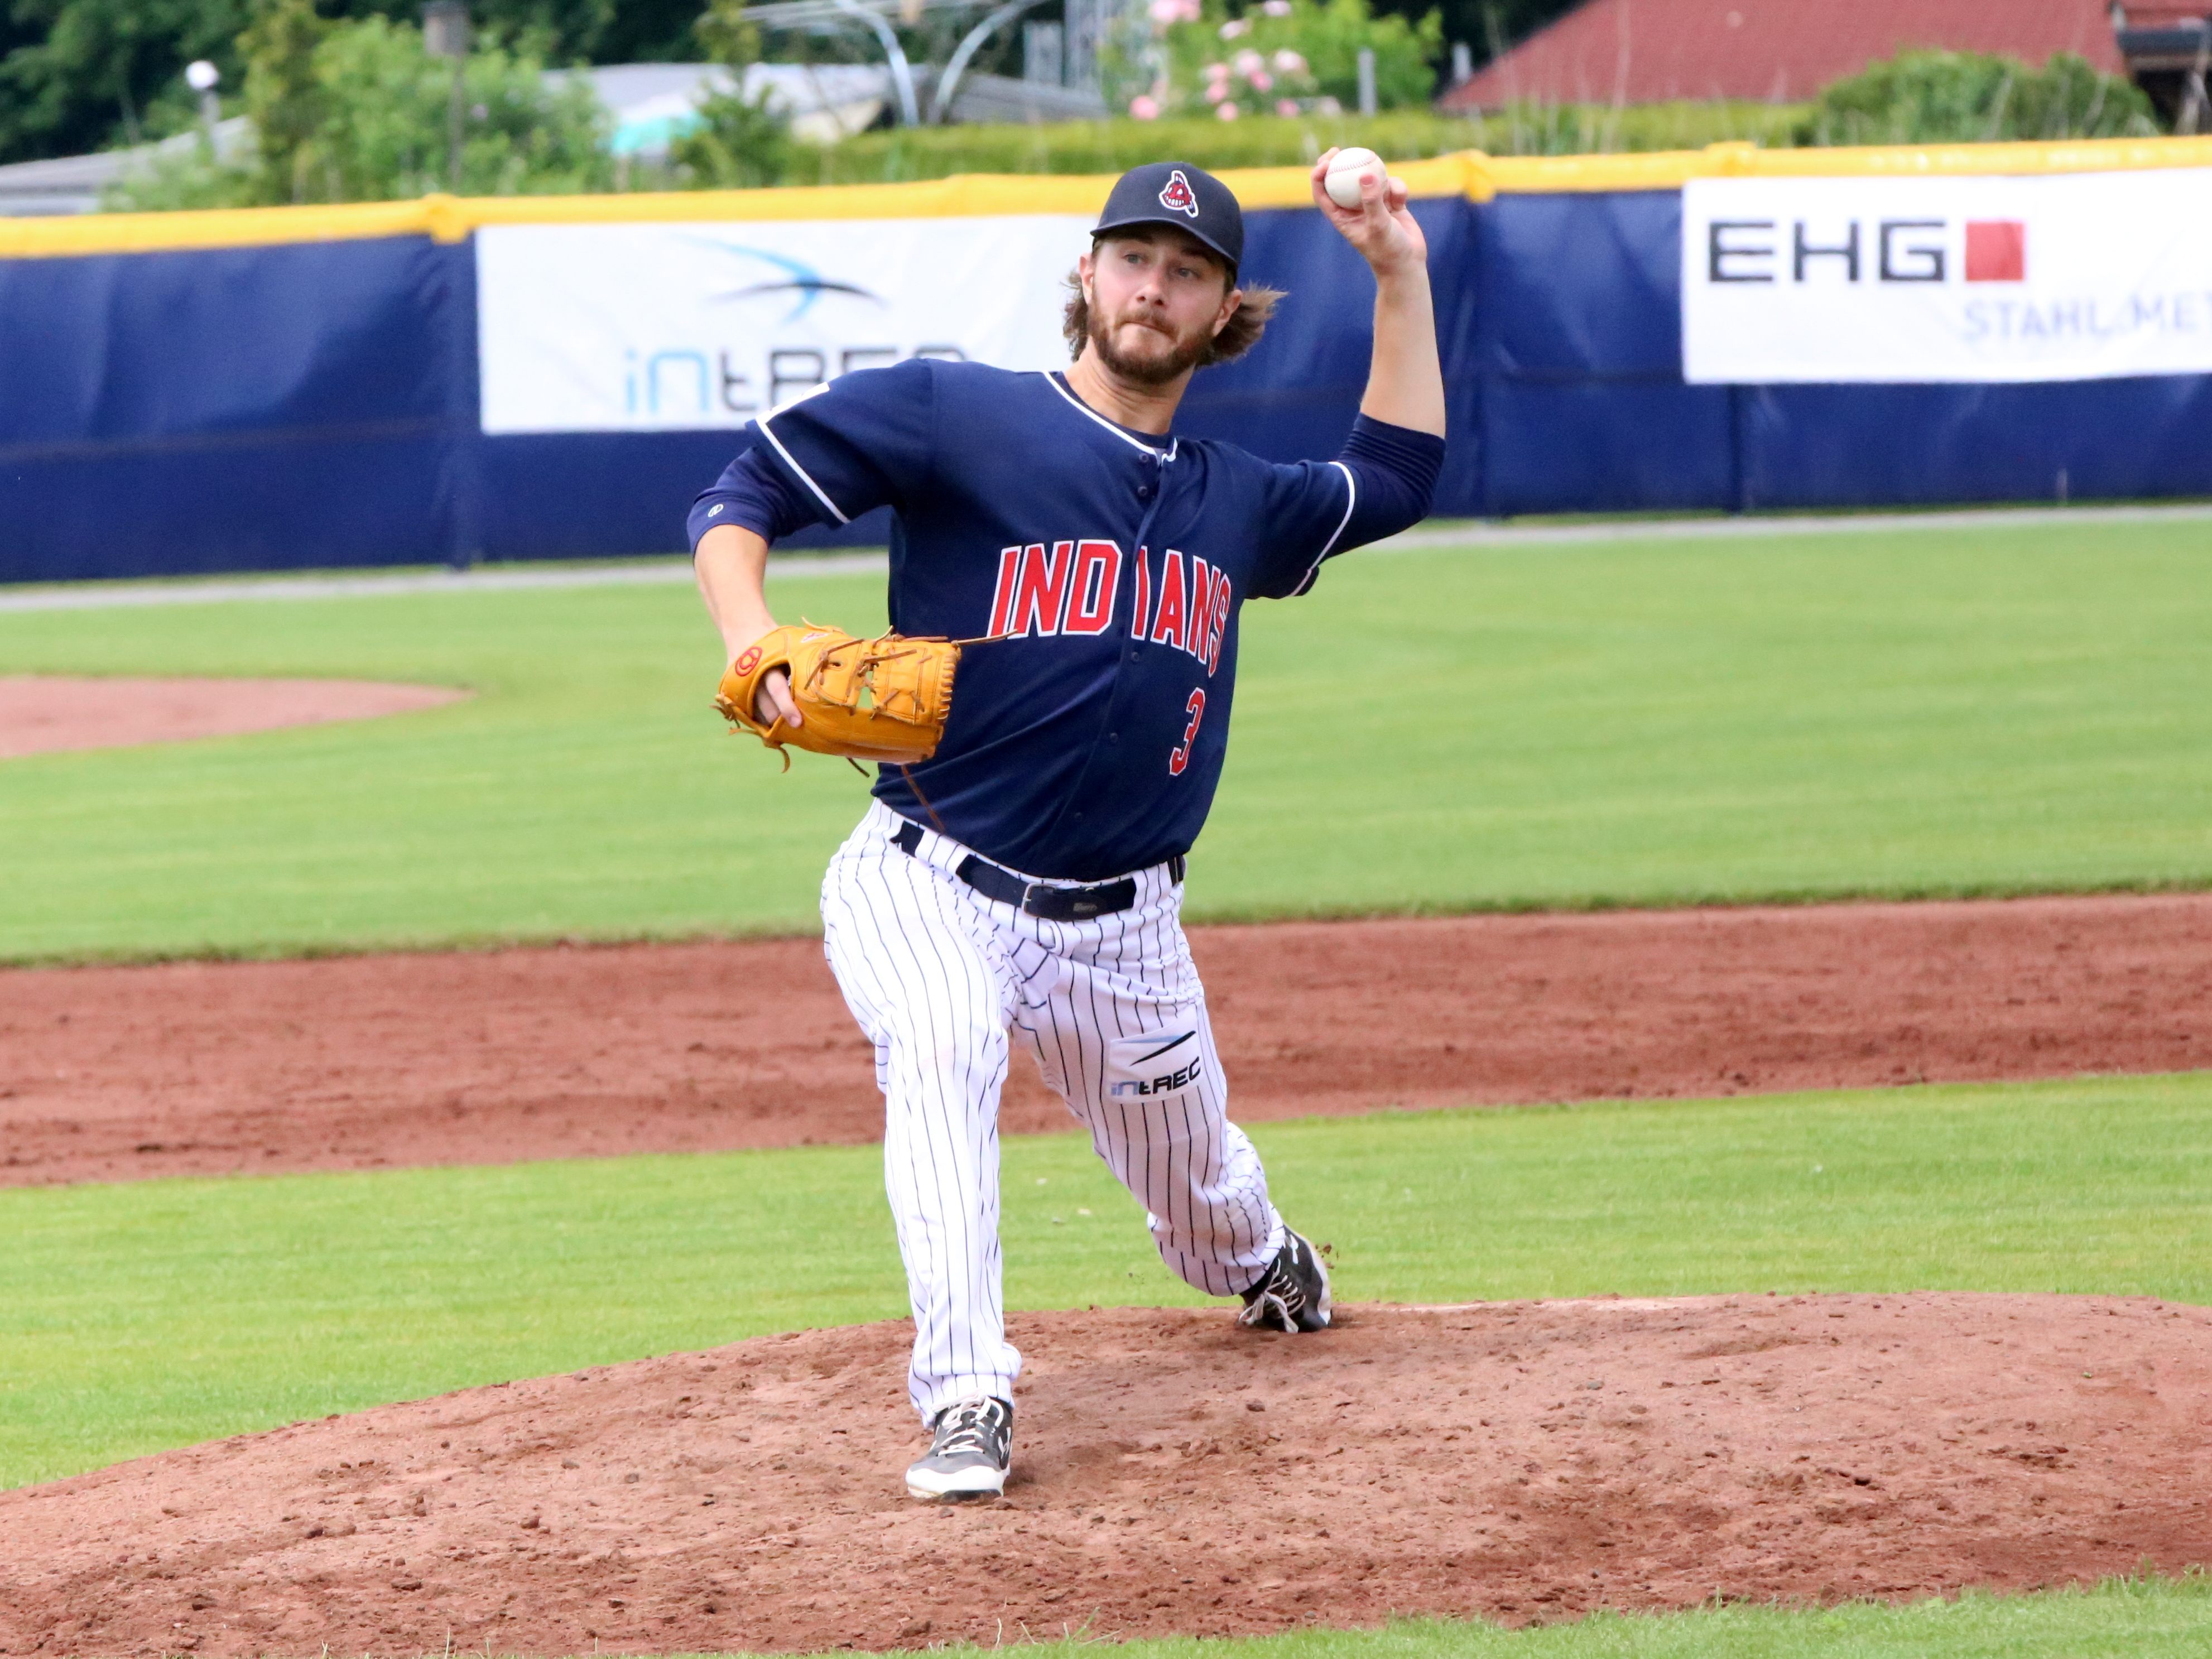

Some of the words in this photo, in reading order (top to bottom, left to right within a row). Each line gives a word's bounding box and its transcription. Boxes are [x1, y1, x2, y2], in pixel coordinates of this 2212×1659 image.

[1708, 219, 1946, 282] EHG
[986, 539, 1232, 678] INDIANS
[1170, 686, 1206, 776] 3
